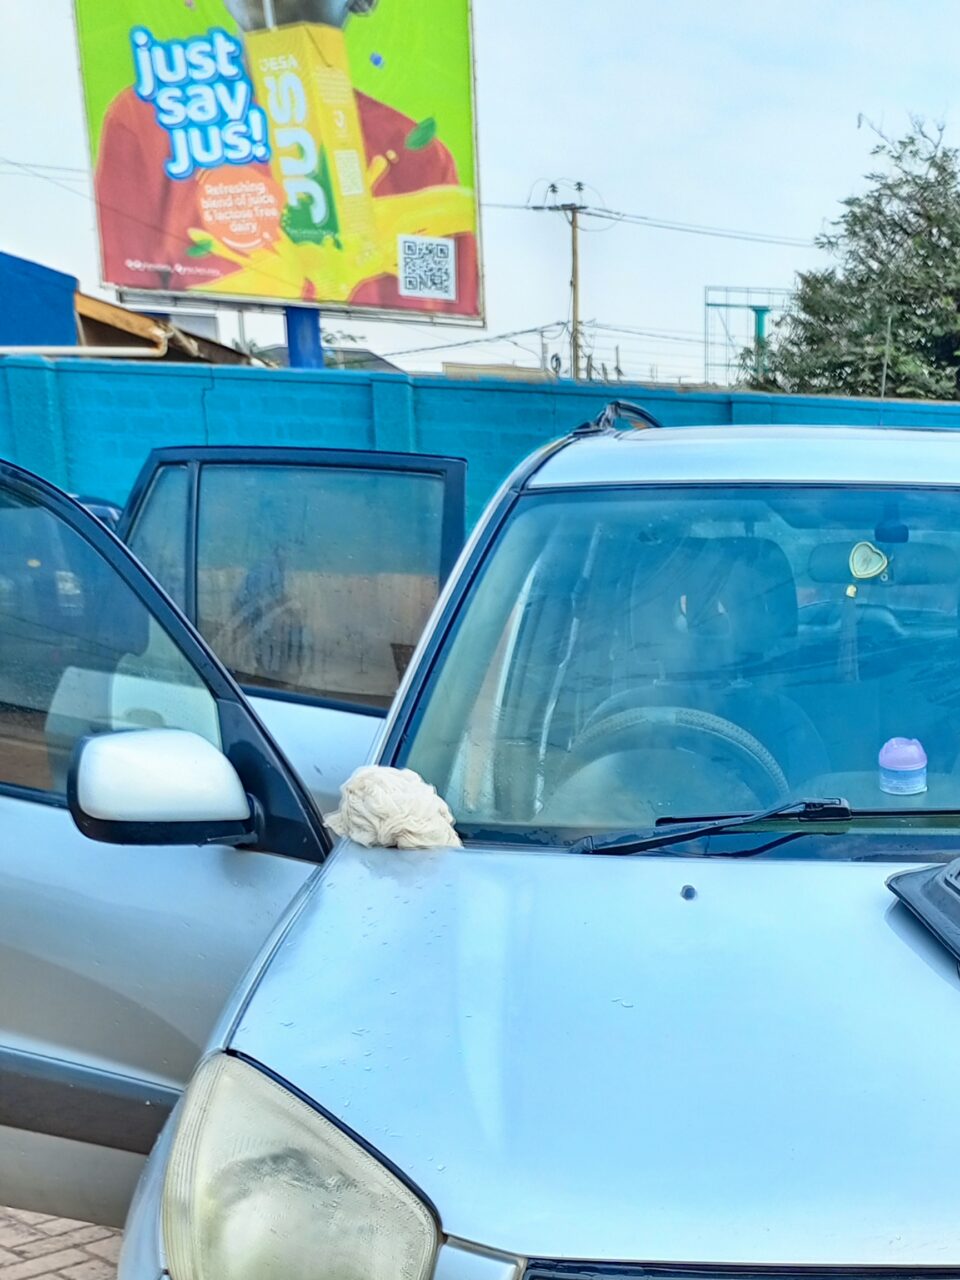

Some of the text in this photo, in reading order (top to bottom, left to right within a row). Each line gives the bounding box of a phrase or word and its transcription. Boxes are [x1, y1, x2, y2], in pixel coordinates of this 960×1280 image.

[133, 31, 240, 97] just
[205, 181, 266, 196] Refreshing
[201, 194, 233, 209] blend
[253, 206, 278, 217] free
[229, 220, 258, 235] dairy
